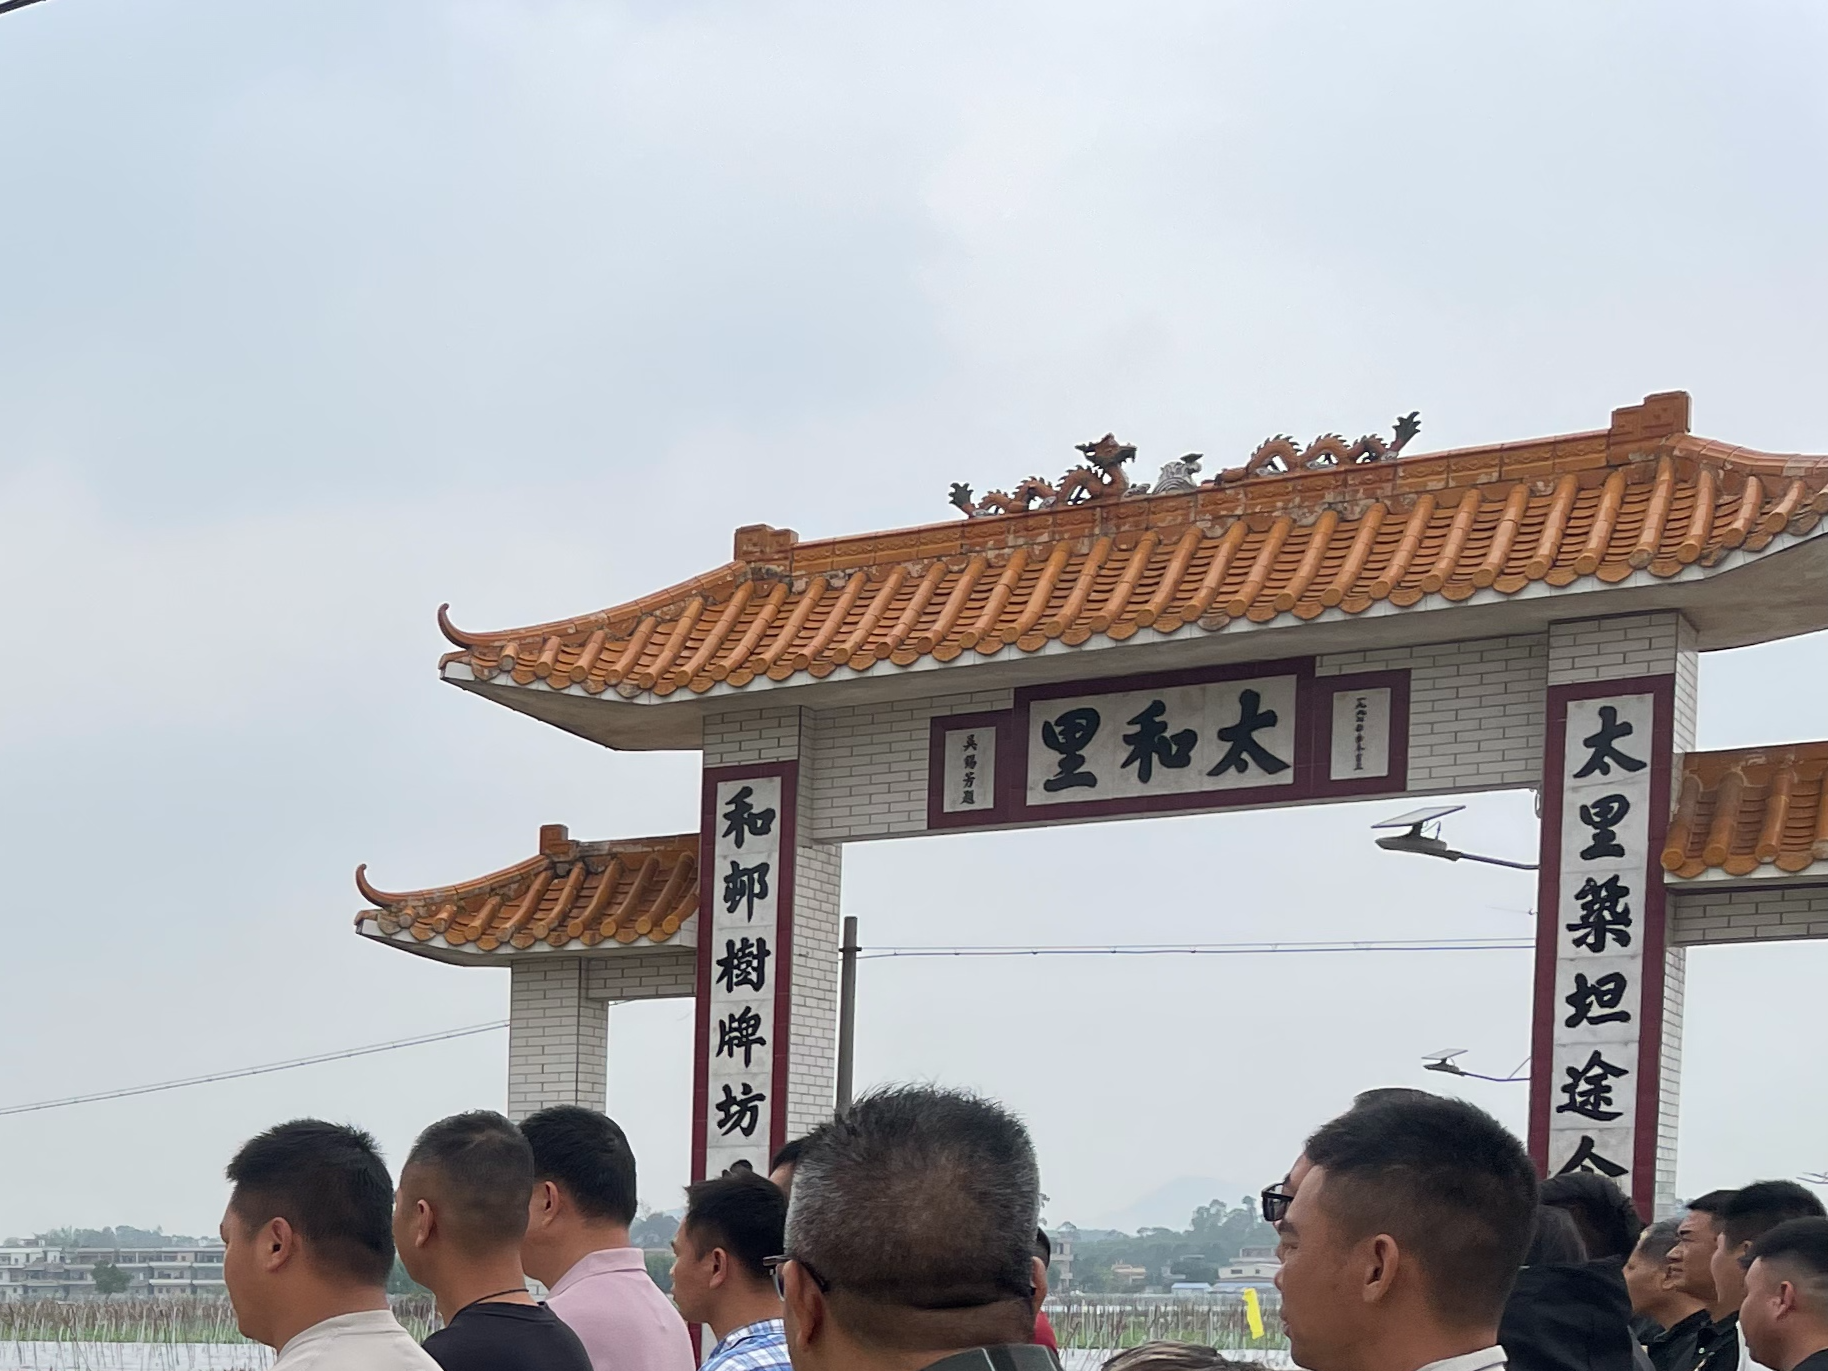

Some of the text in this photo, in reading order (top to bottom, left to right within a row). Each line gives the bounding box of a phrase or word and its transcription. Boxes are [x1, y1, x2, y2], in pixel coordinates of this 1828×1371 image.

[715, 785, 777, 1178] 和邨樹牌坊
